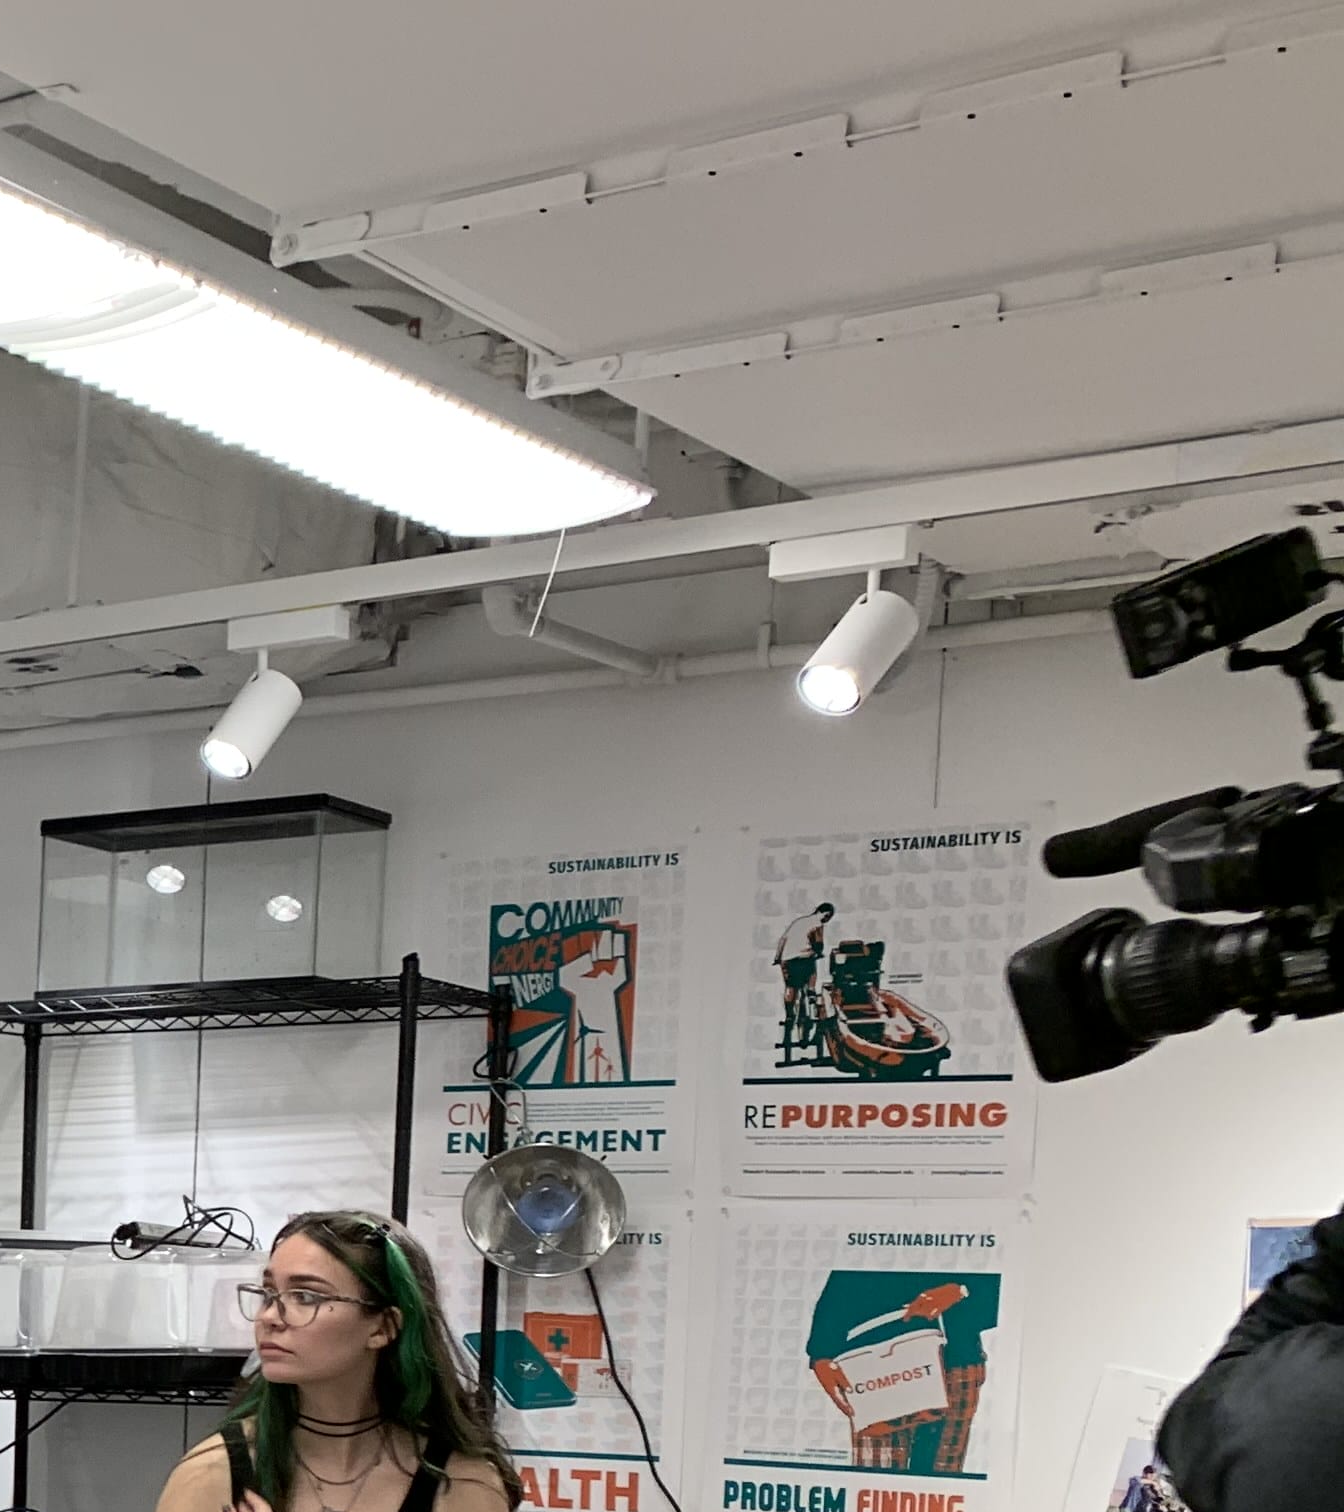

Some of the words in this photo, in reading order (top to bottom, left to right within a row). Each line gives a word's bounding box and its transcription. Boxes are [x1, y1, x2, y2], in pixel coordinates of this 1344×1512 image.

[869, 831, 1001, 853] SUSTAINABILITY
[1005, 830, 1022, 845] IS
[548, 854, 661, 875] SUSTAINABILITY
[664, 852, 680, 867] IS
[496, 896, 624, 939] COMMUNITY
[492, 932, 562, 975] CHOICE
[491, 971, 555, 1008] NERG
[448, 1102, 523, 1127] CIVC
[743, 1102, 1009, 1130] REPURPOSING
[447, 1128, 667, 1154] ENAGEMENT
[648, 1232, 662, 1245] IS
[847, 1232, 975, 1248] SUSTAINABILITY
[980, 1233, 996, 1248] IS
[854, 1363, 933, 1395] COMPOST
